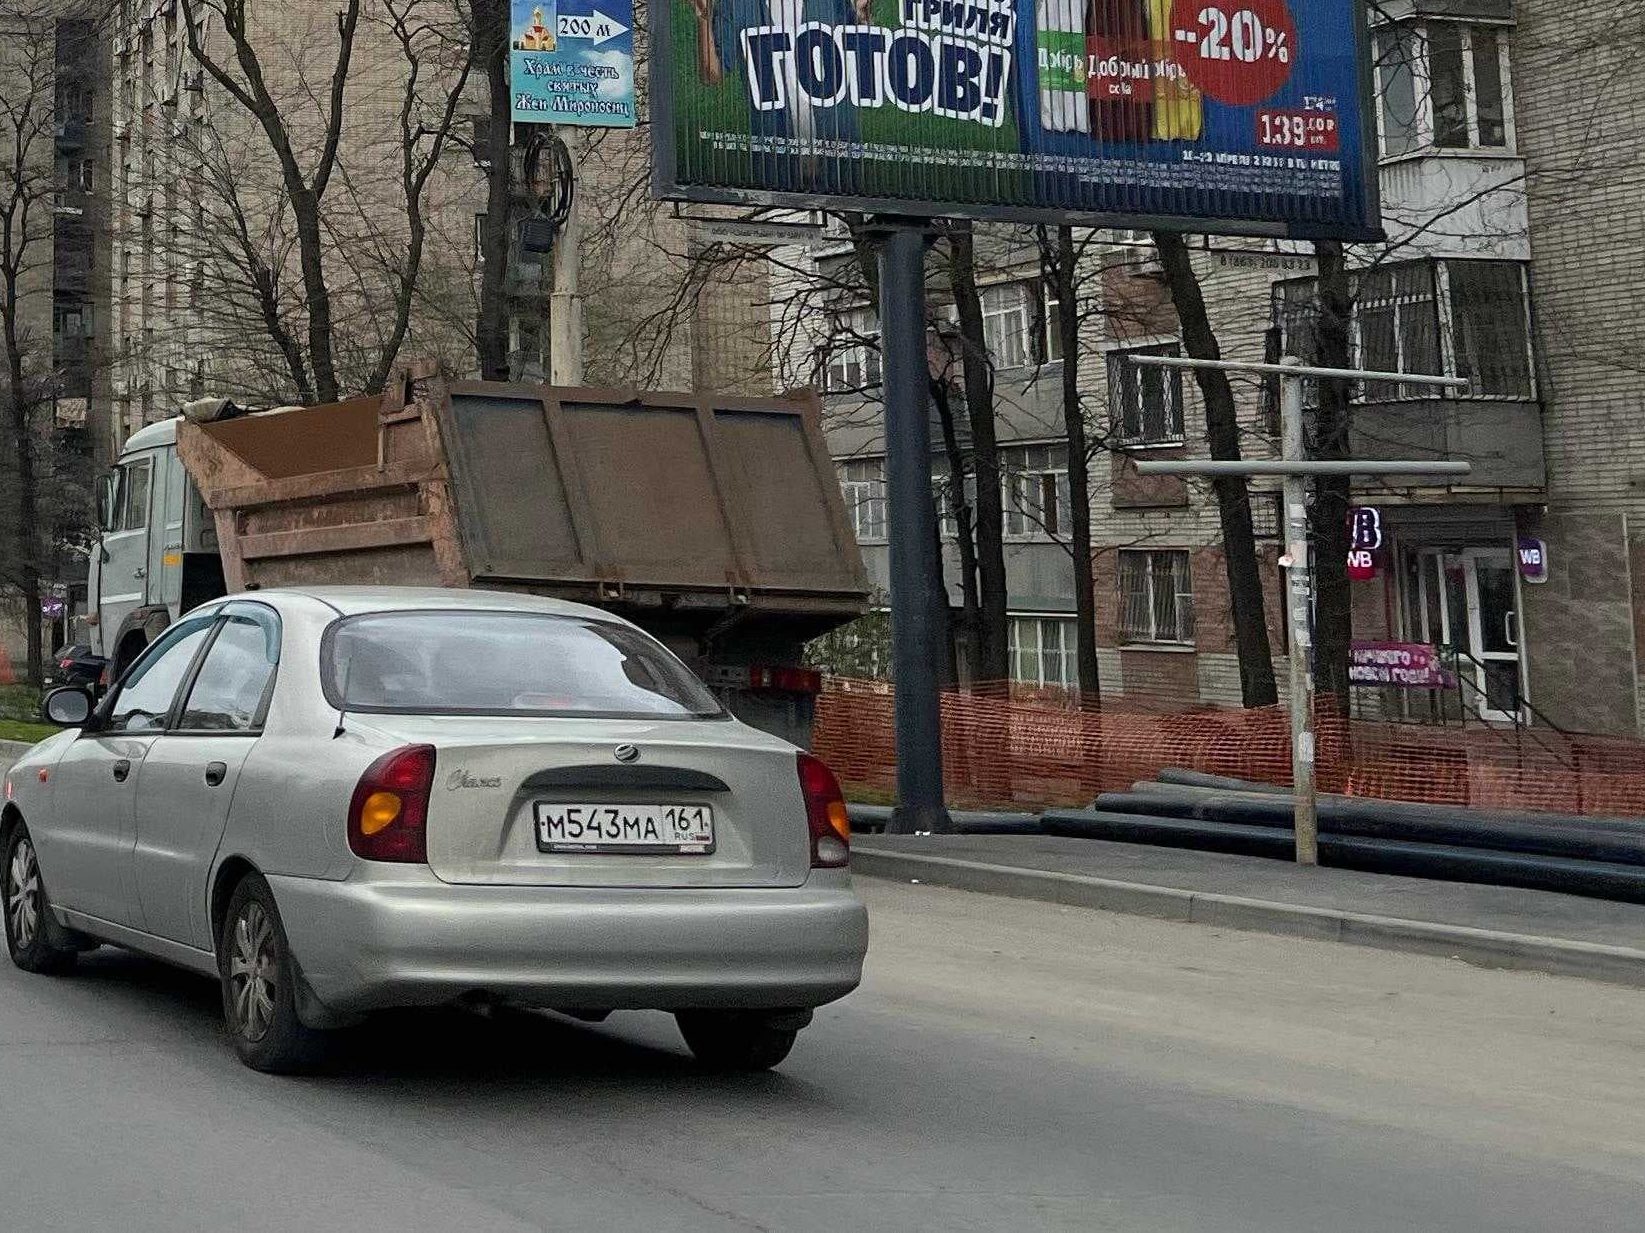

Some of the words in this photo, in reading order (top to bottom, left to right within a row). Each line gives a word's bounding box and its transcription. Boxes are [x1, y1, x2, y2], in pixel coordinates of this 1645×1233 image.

[560, 17, 591, 36] 200
[596, 24, 612, 37] м
[524, 57, 563, 79] Храм
[580, 67, 620, 79] честь
[747, 29, 1003, 119] ГОТОВ!
[547, 79, 599, 98] святых
[516, 92, 548, 111] Жен
[552, 95, 630, 118] Мироносиц
[1519, 548, 1541, 564] WB
[666, 808, 705, 832] 161
[674, 832, 695, 841] RUS
